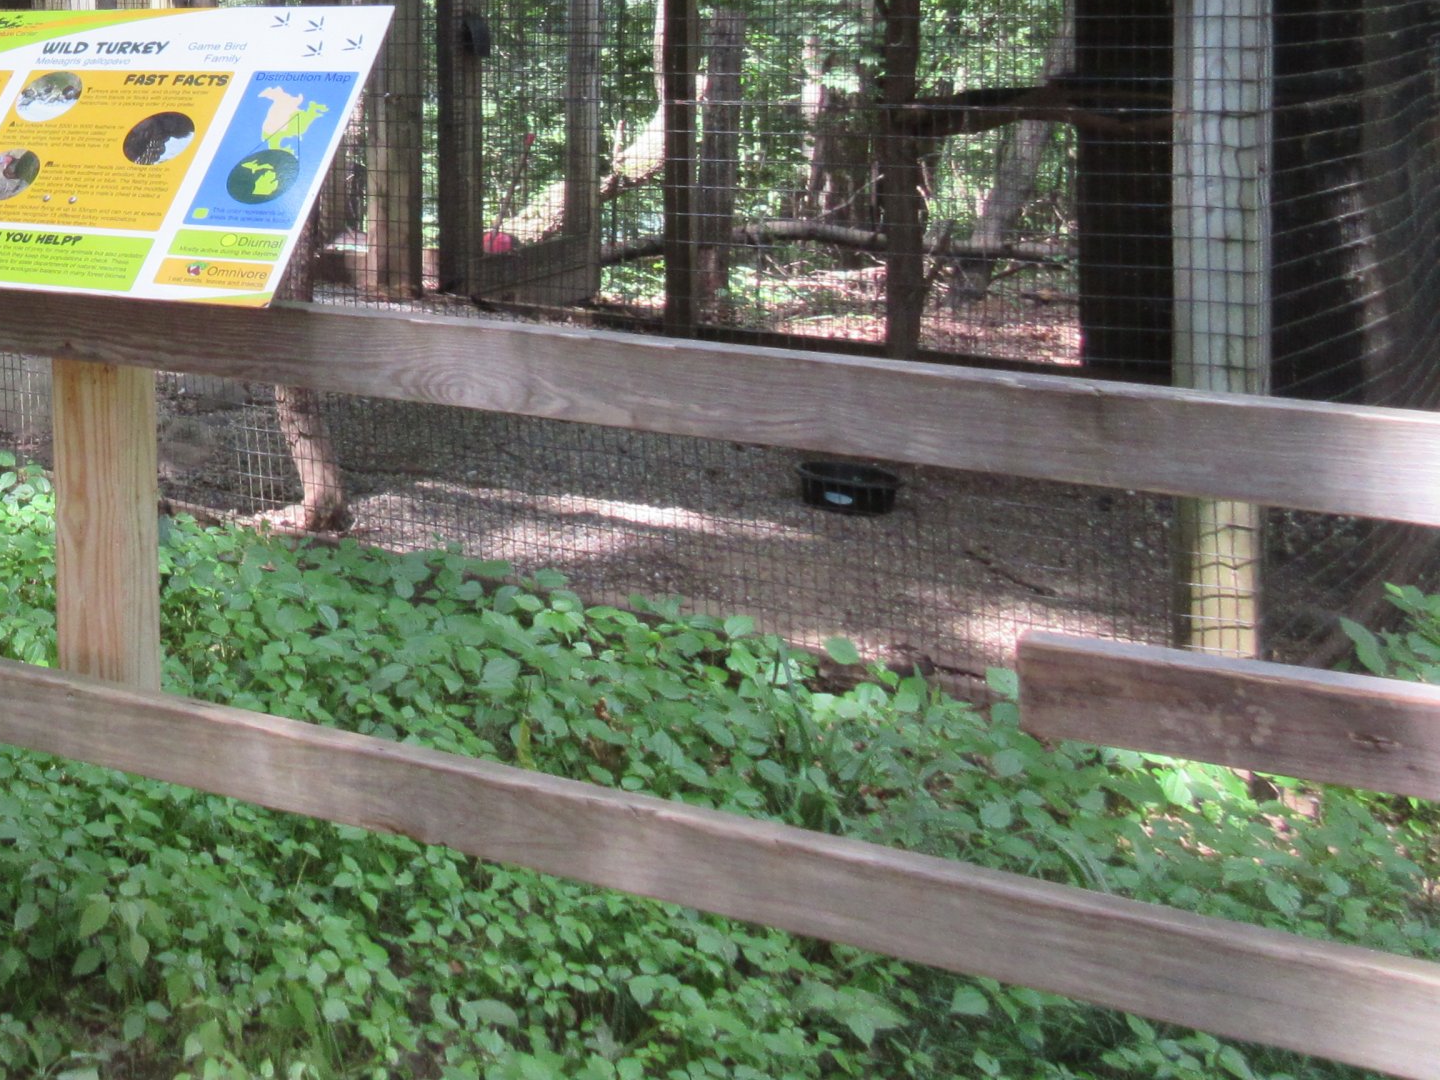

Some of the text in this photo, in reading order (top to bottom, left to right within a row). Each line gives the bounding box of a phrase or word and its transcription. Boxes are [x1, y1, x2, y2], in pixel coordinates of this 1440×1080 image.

[42, 41, 170, 55] WILD TURKEY
[188, 41, 248, 51] Game Bird
[35, 57, 131, 66] Meleagris gallopavo
[203, 54, 241, 64] Family
[123, 74, 229, 86] FAST FACTS
[255, 72, 352, 83] Distribution Map
[5, 231, 33, 243] YOU
[238, 236, 283, 248] Diurnal
[207, 266, 267, 279] Omnivore
